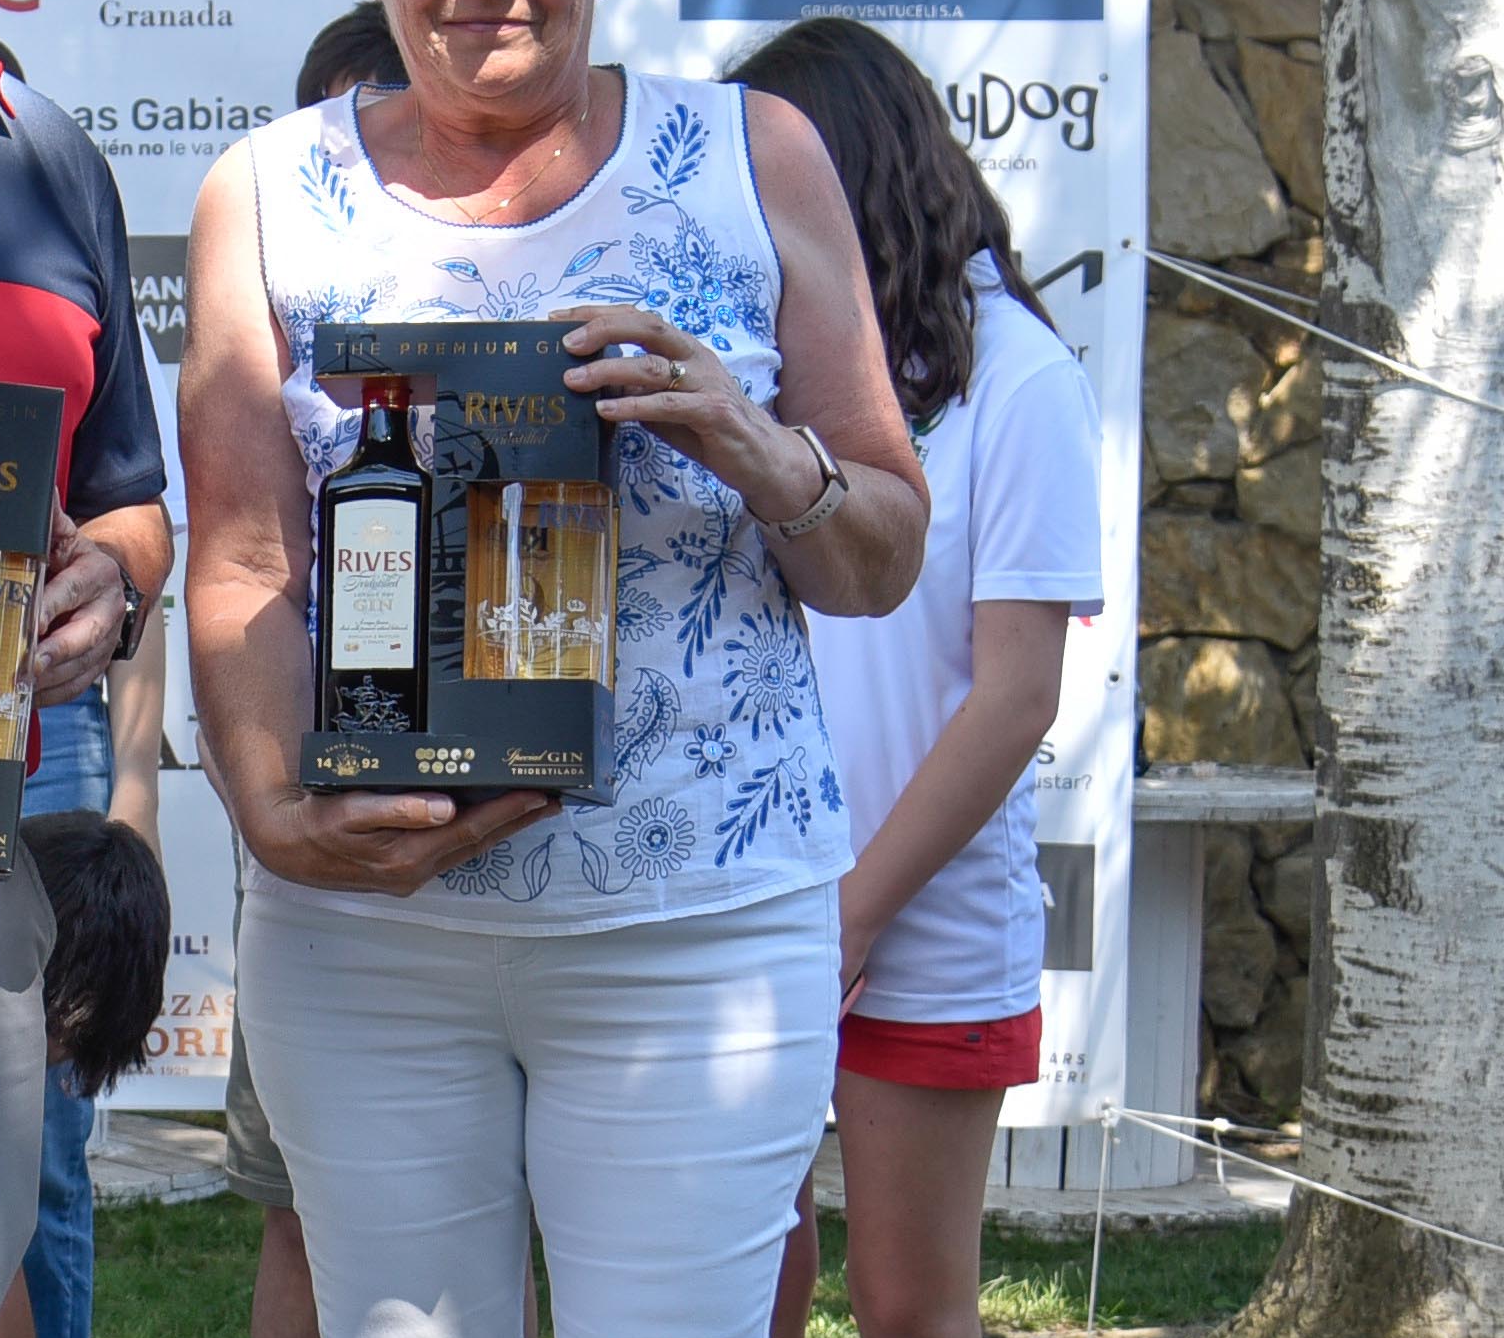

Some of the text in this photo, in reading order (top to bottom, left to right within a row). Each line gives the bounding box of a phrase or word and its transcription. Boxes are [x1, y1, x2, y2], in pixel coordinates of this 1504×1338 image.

[99, 0, 234, 28] Granada
[800, 3, 853, 19] GRUPO
[132, 98, 274, 132] Gabias
[138, 143, 164, 157] no
[169, 140, 188, 157] le
[191, 143, 214, 157] va
[335, 341, 381, 357] THE
[399, 341, 519, 355] PREMIUM
[464, 391, 567, 427] RIVES
[337, 548, 413, 573] RIVES
[353, 598, 393, 612] GIN
[316, 757, 333, 770] 14
[361, 757, 380, 770] 92
[547, 749, 584, 763] GIN
[511, 767, 585, 777] TRIDESTILADA
